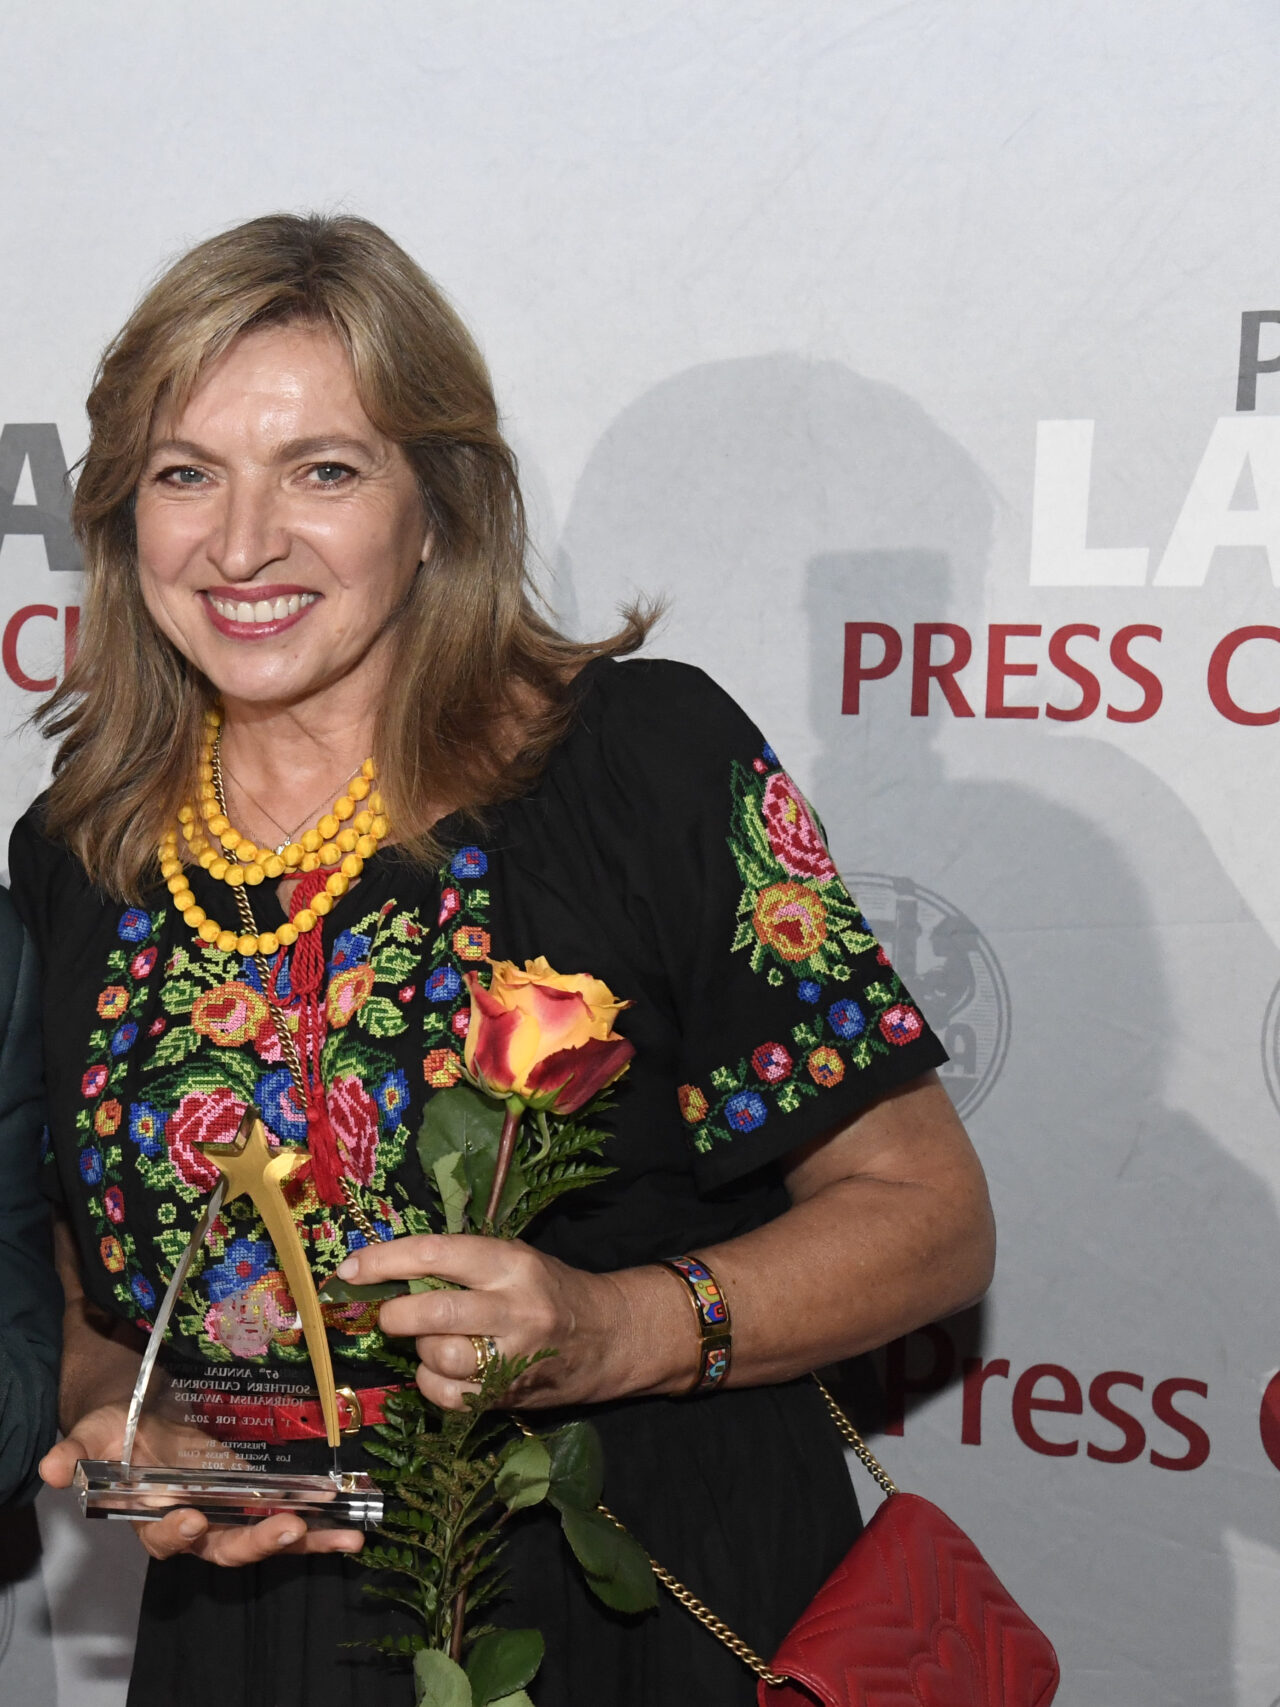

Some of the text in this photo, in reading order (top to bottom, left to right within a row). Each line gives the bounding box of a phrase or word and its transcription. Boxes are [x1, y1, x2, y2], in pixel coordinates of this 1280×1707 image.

[1029, 415, 1280, 588] LA
[840, 621, 1164, 724] PRESS
[884, 1322, 1211, 1471] Press
